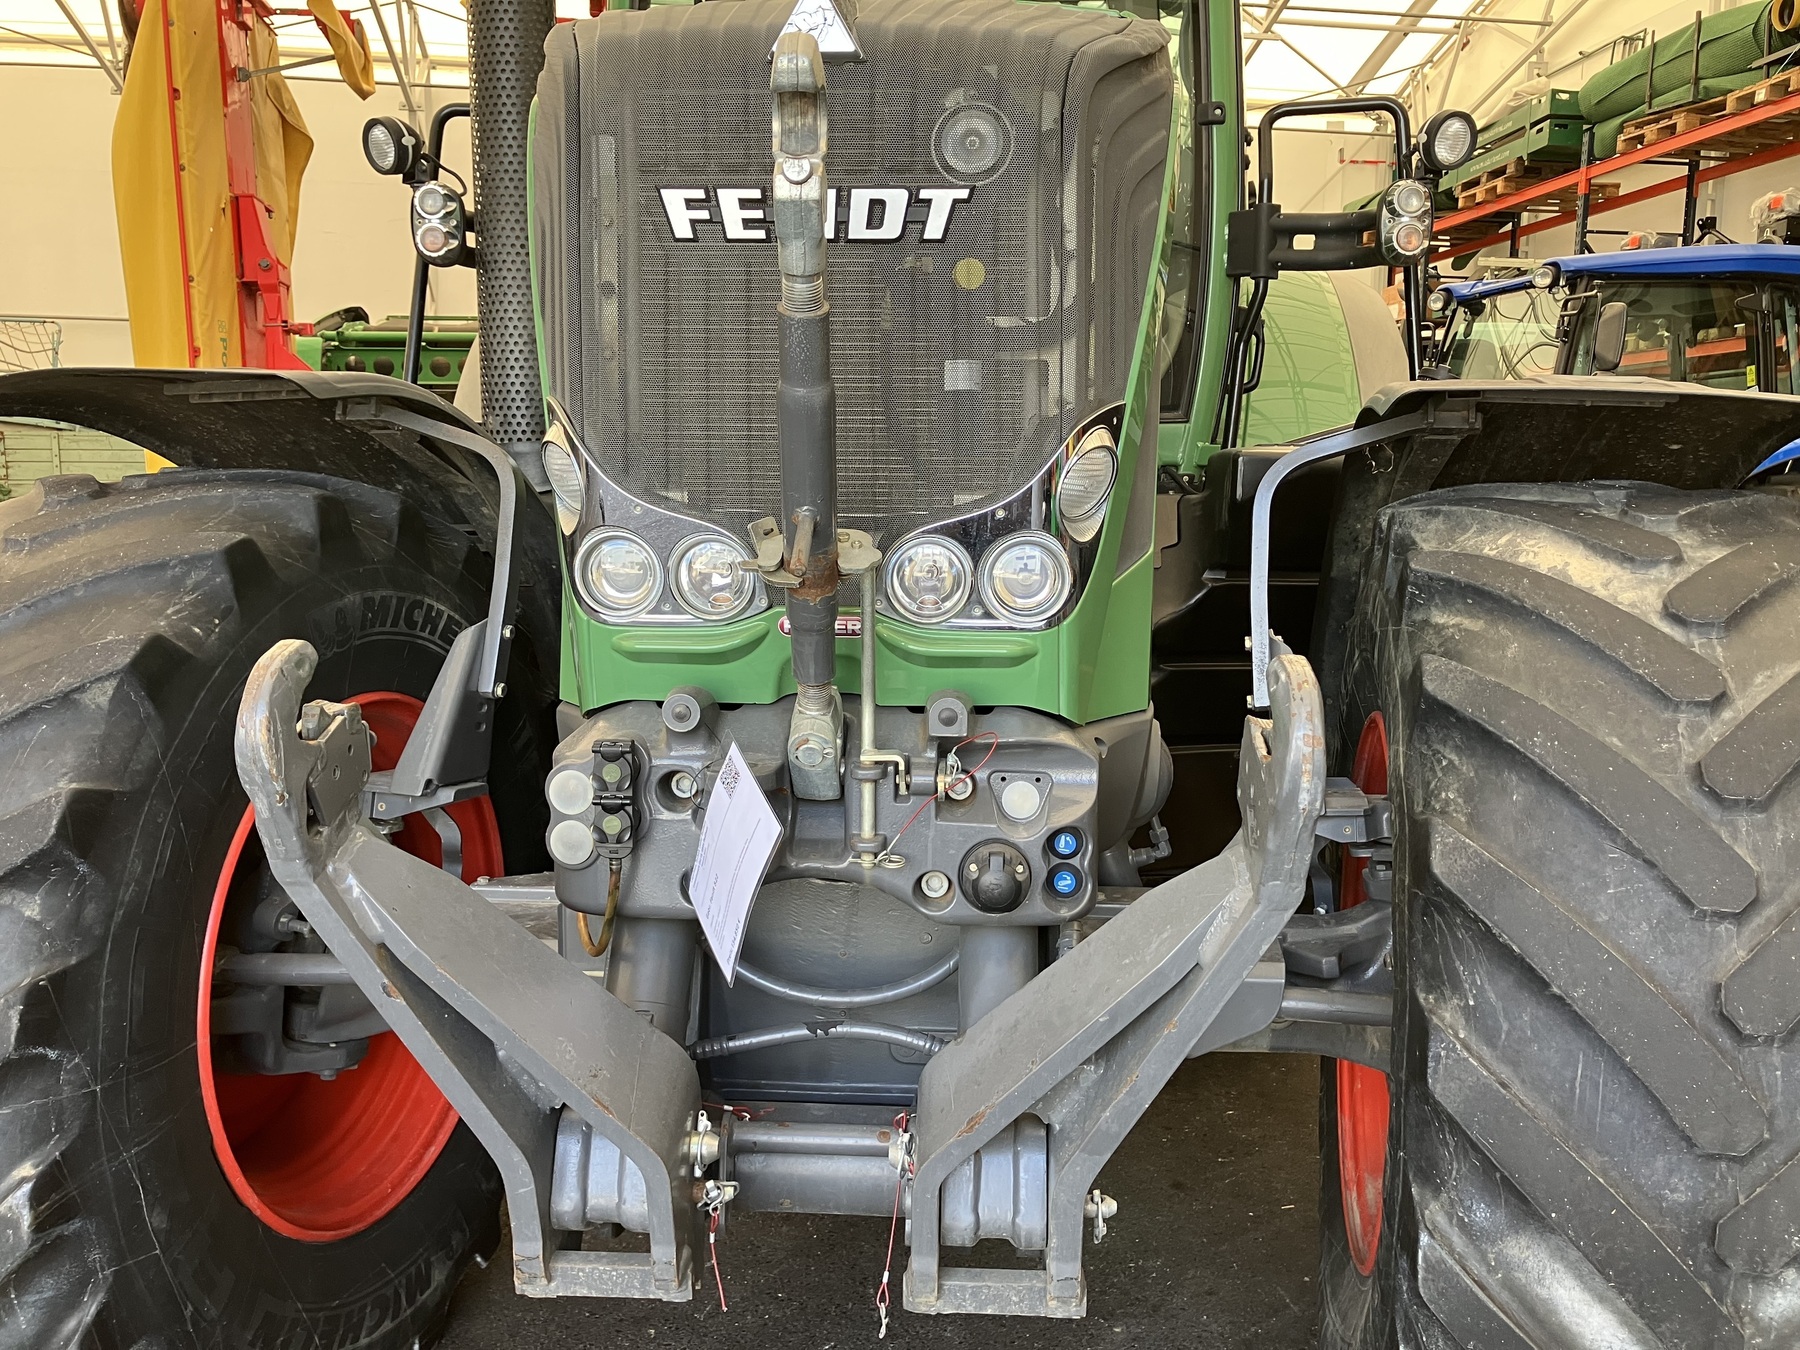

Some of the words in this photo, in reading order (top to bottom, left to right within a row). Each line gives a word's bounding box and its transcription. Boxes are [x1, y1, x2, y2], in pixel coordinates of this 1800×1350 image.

[656, 185, 975, 242] FEDT
[360, 594, 463, 645] MICHE
[783, 620, 862, 634] PER
